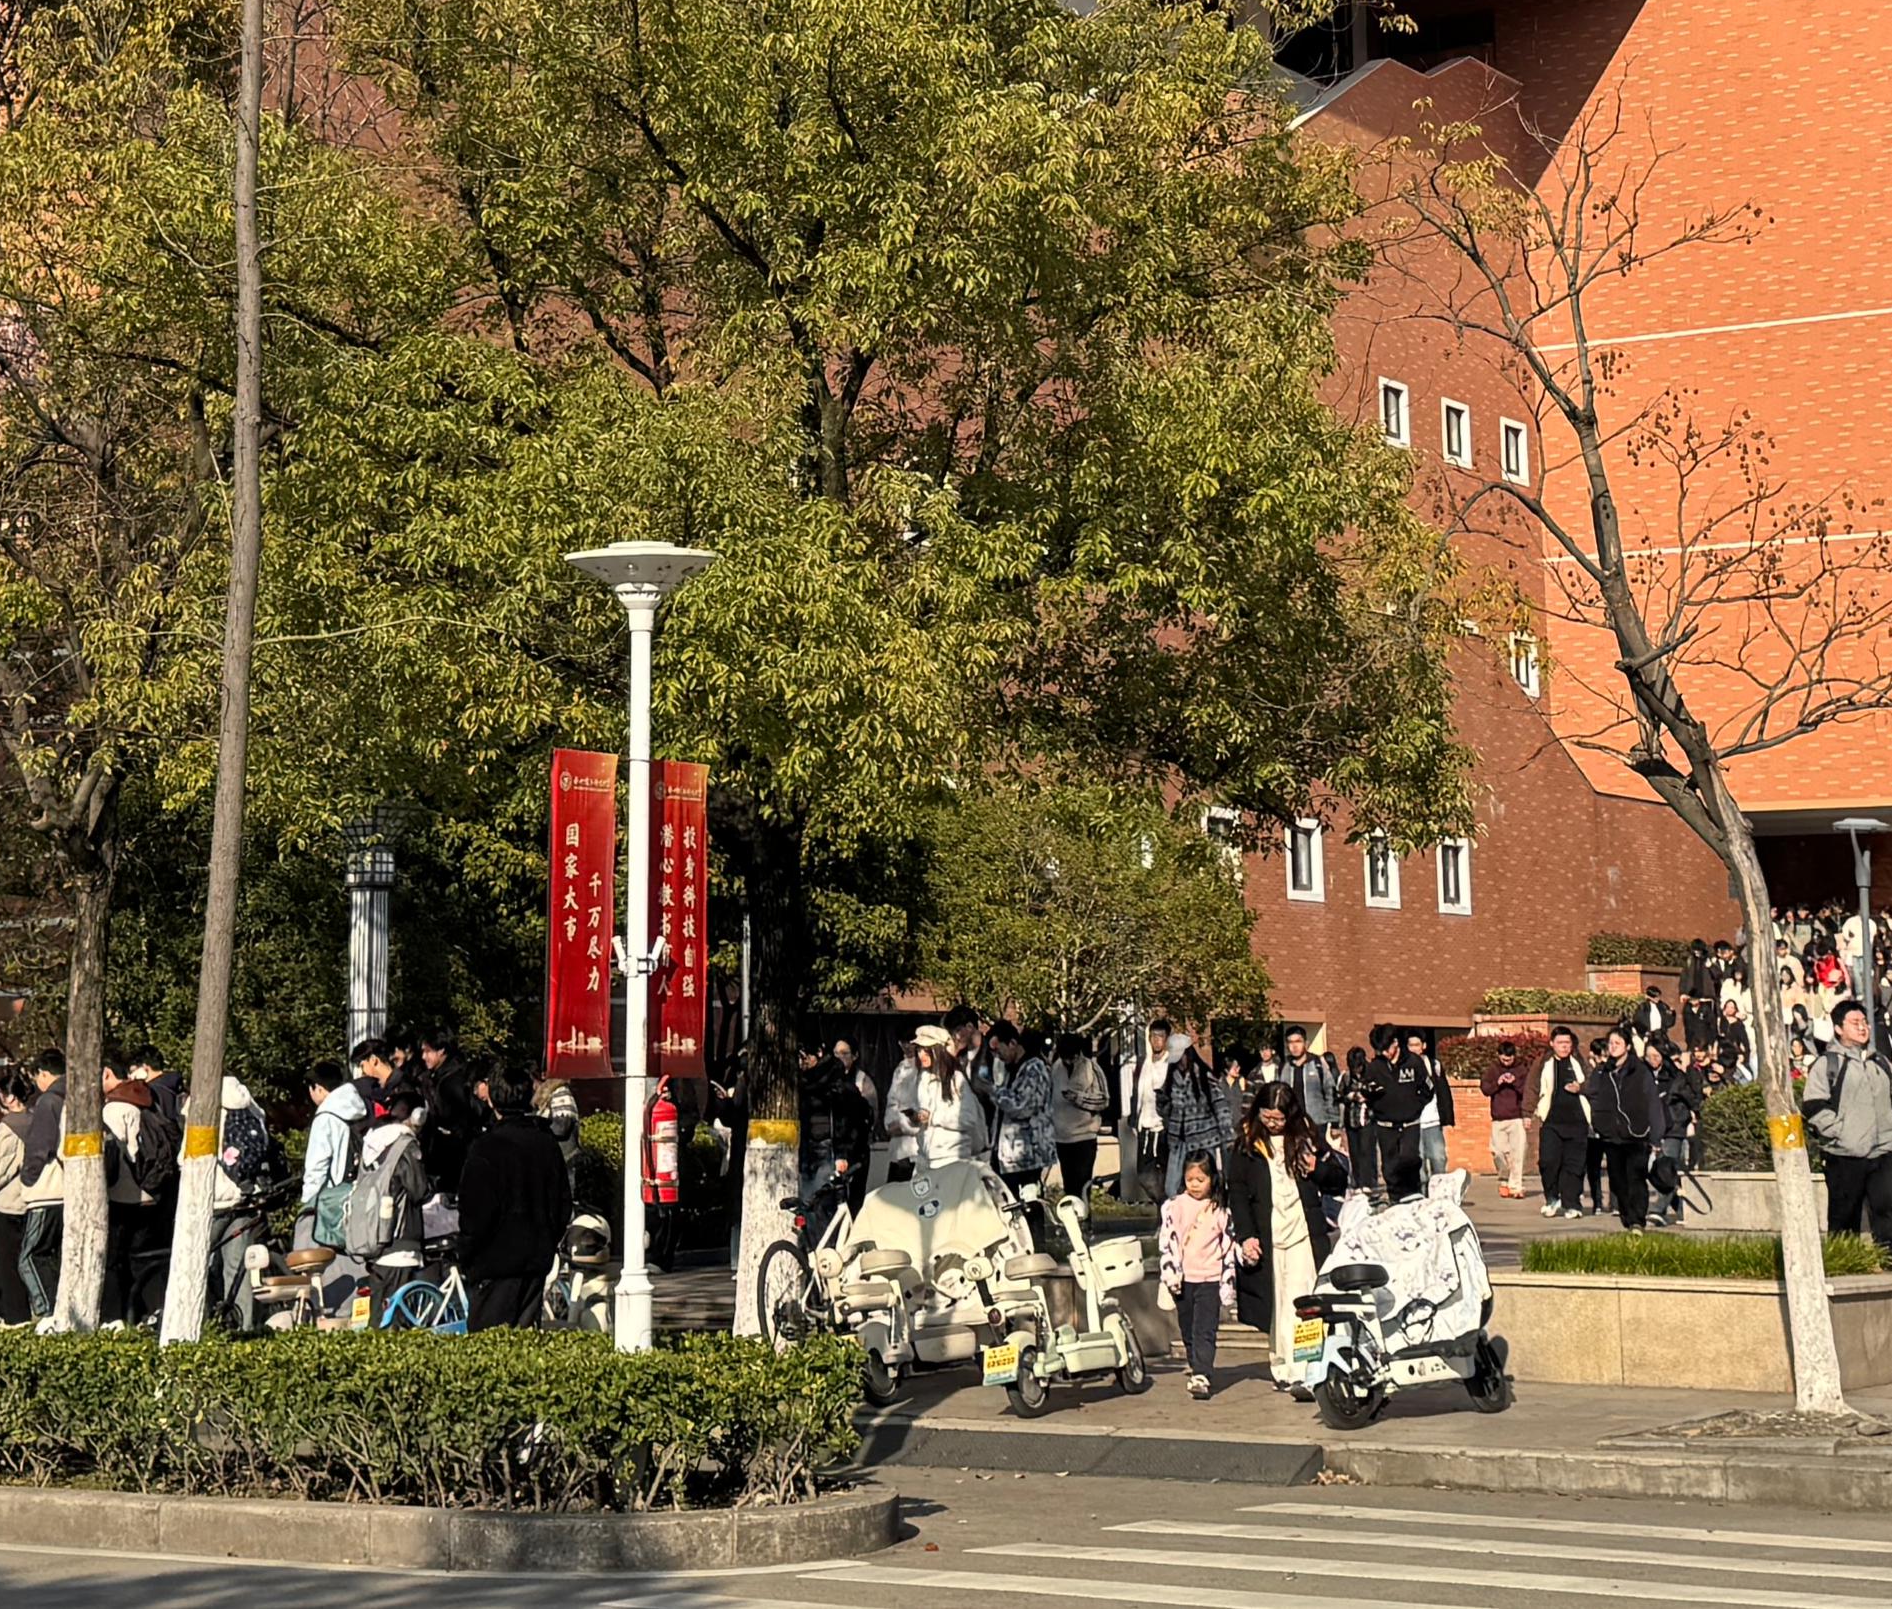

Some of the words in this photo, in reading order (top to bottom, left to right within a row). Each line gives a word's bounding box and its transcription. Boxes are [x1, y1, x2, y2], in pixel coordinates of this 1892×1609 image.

[562, 822, 580, 942] 国家大事
[586, 871, 603, 992] 千万尽力
